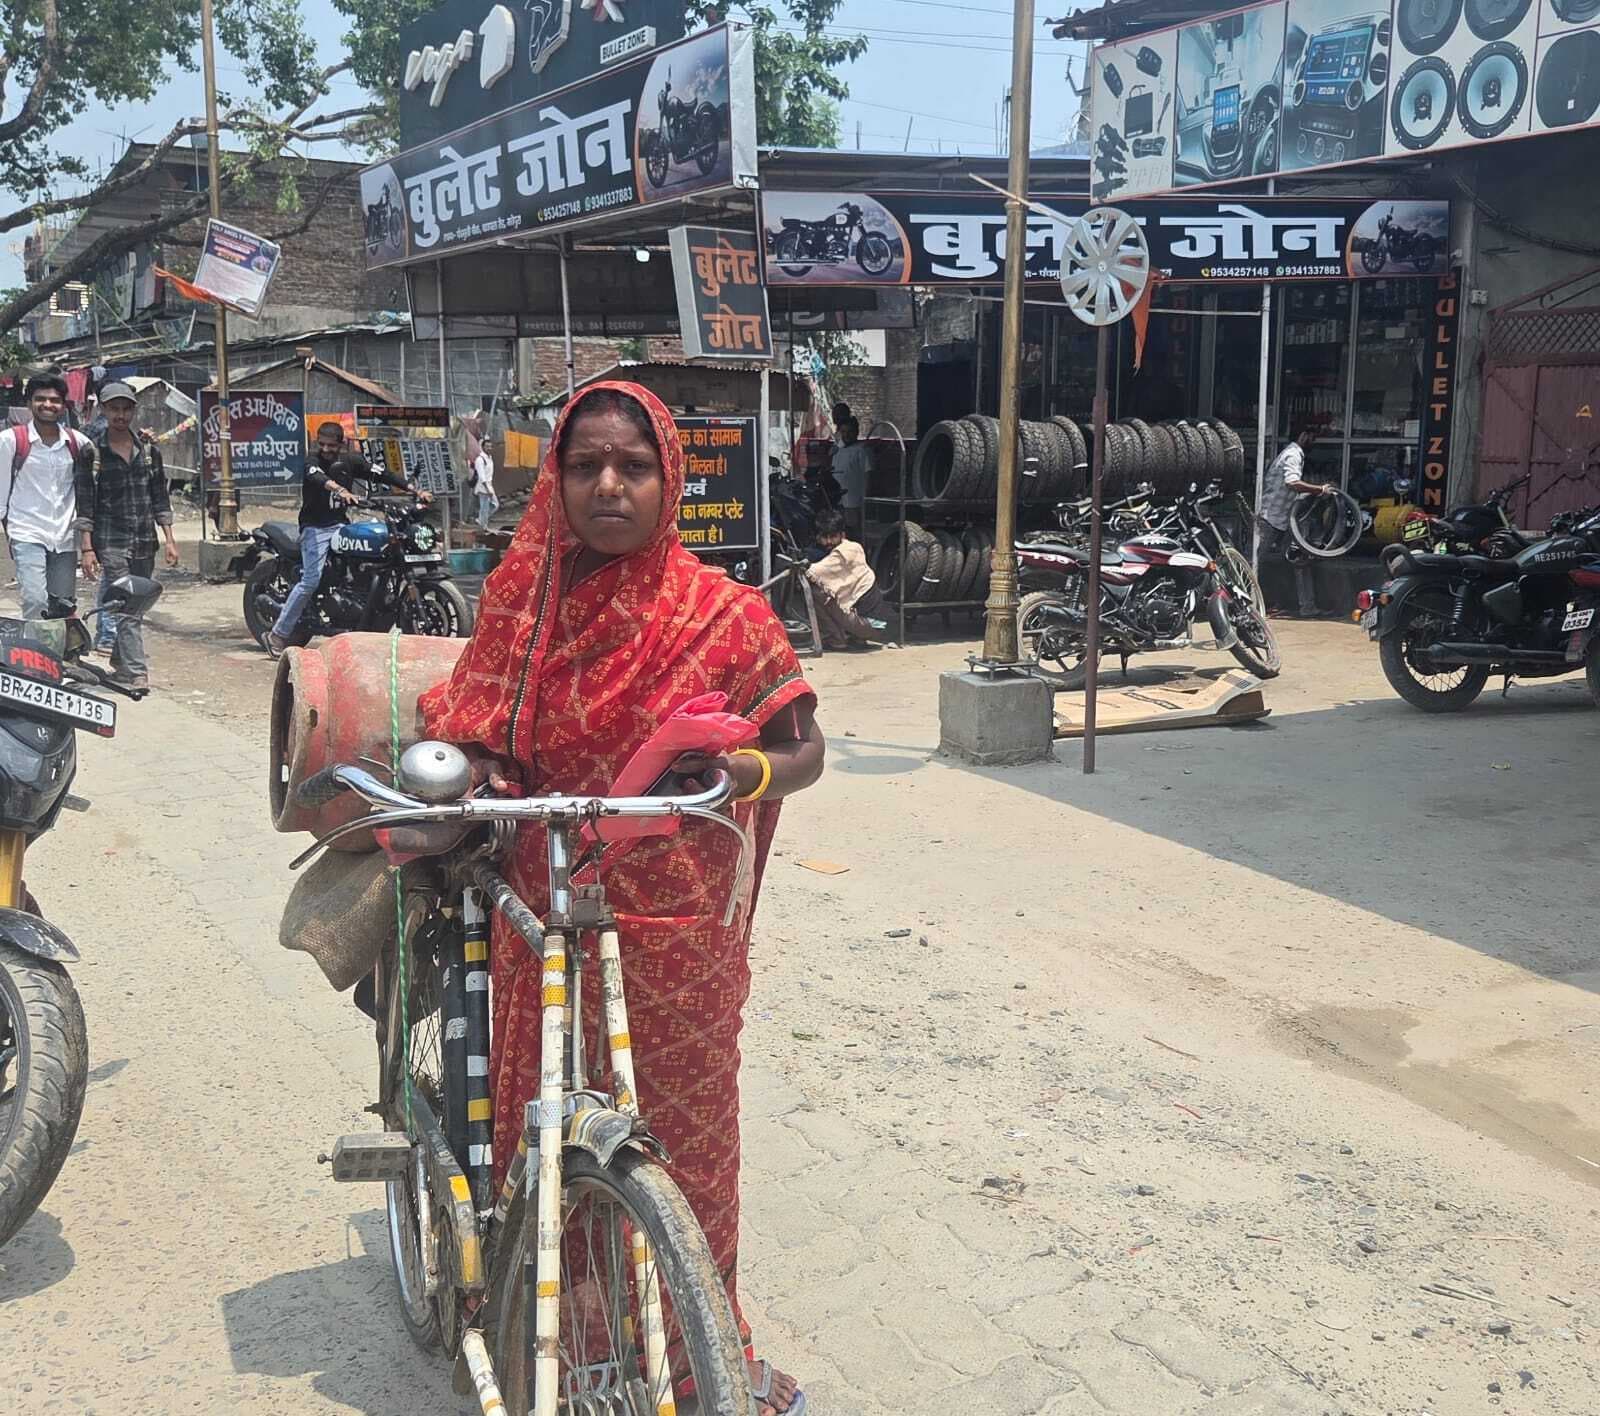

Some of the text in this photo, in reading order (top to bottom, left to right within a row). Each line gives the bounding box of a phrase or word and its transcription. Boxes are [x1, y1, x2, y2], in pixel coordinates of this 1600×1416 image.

[602, 30, 647, 60] BULLET ZONE
[404, 98, 632, 248] बुलेट जोन
[1159, 203, 1345, 260] जोन
[690, 237, 759, 297] बुलेट
[1210, 266, 1269, 277] 9534257148
[702, 303, 764, 350] जोन
[244, 393, 300, 432] अधीक्षक
[251, 434, 299, 461] मधेपुरा
[693, 429, 708, 446] का
[710, 429, 743, 446] सामान
[689, 453, 715, 475] मिलता
[682, 503, 697, 520] का
[724, 497, 745, 520] प्लेट
[10, 647, 60, 679] PRESS
